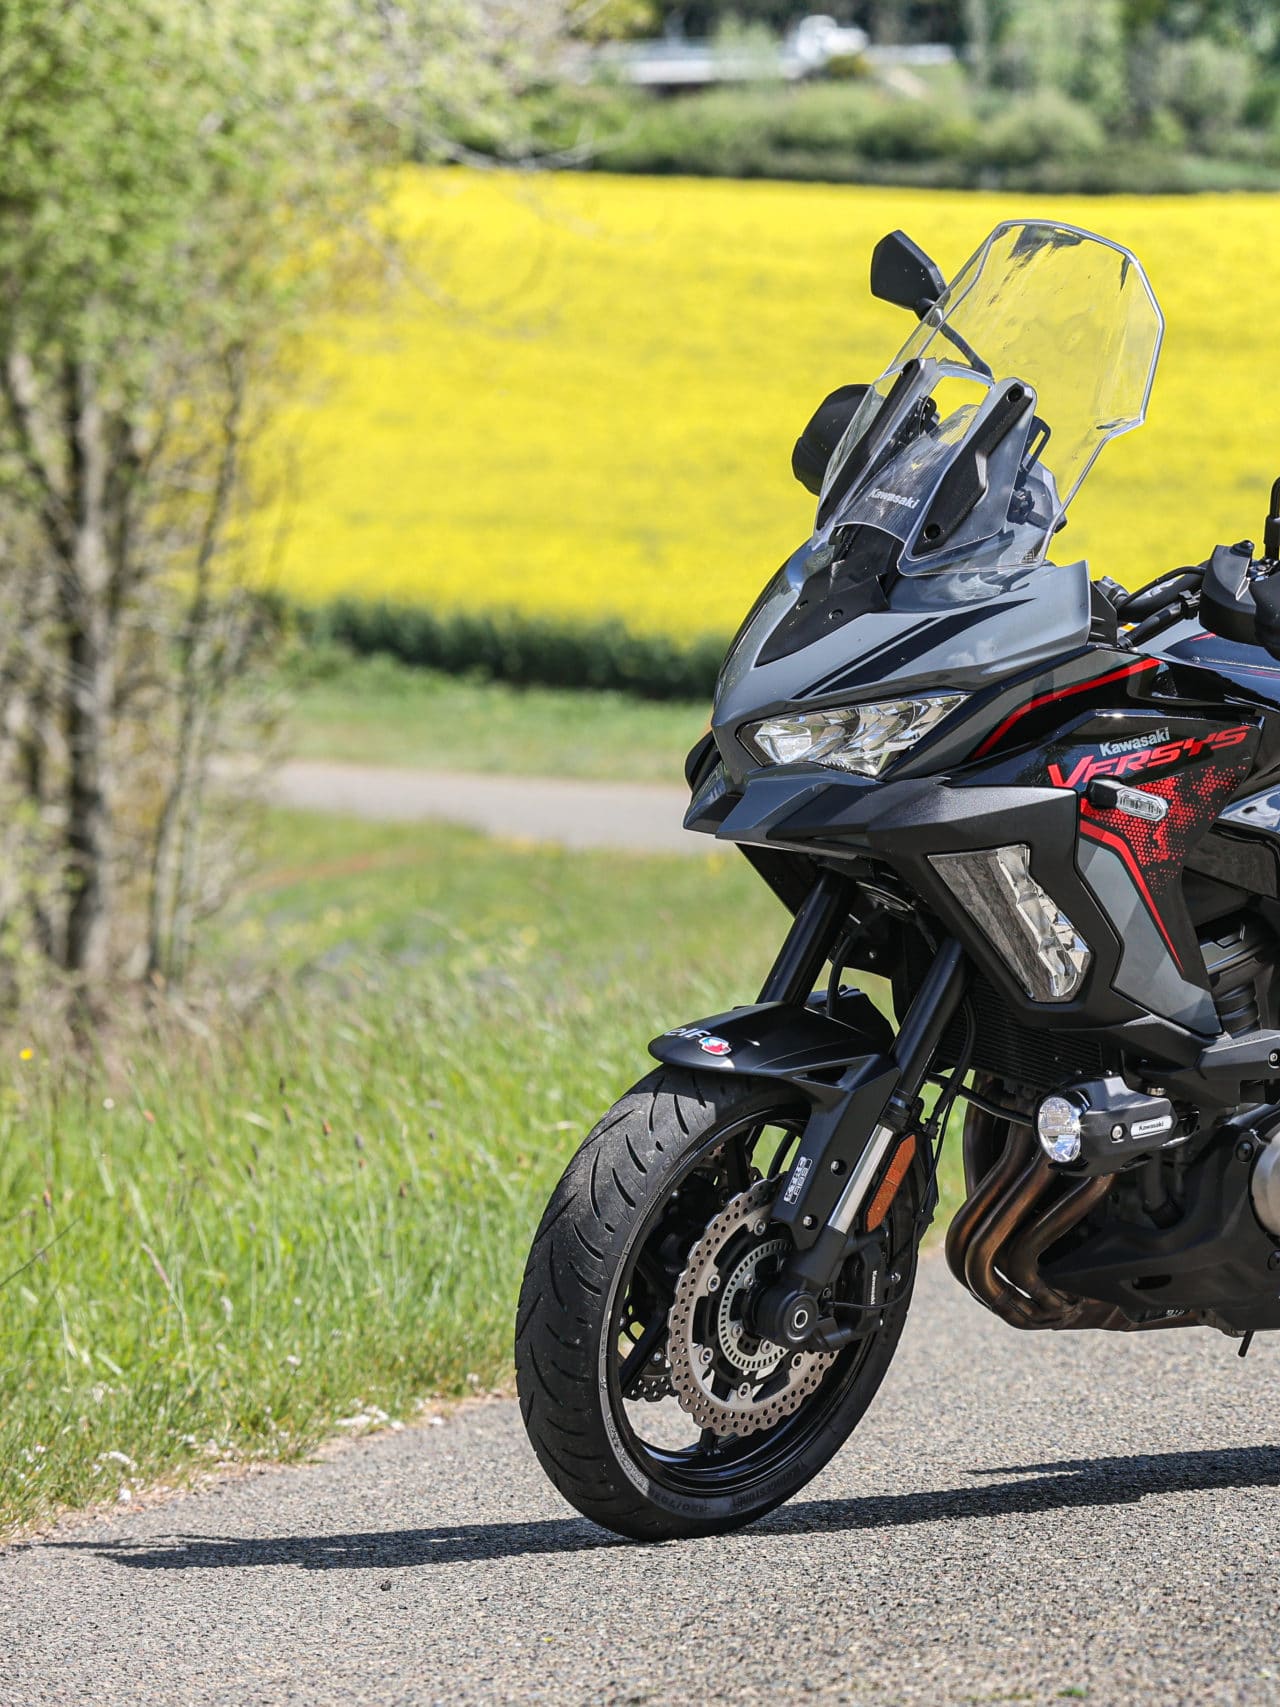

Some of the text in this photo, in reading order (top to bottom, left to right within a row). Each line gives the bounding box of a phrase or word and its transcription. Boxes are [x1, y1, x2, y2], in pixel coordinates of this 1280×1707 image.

[867, 487, 920, 510] Kawasaki
[1047, 725, 1251, 788] VERSYS
[1100, 727, 1170, 757] Kawasaki
